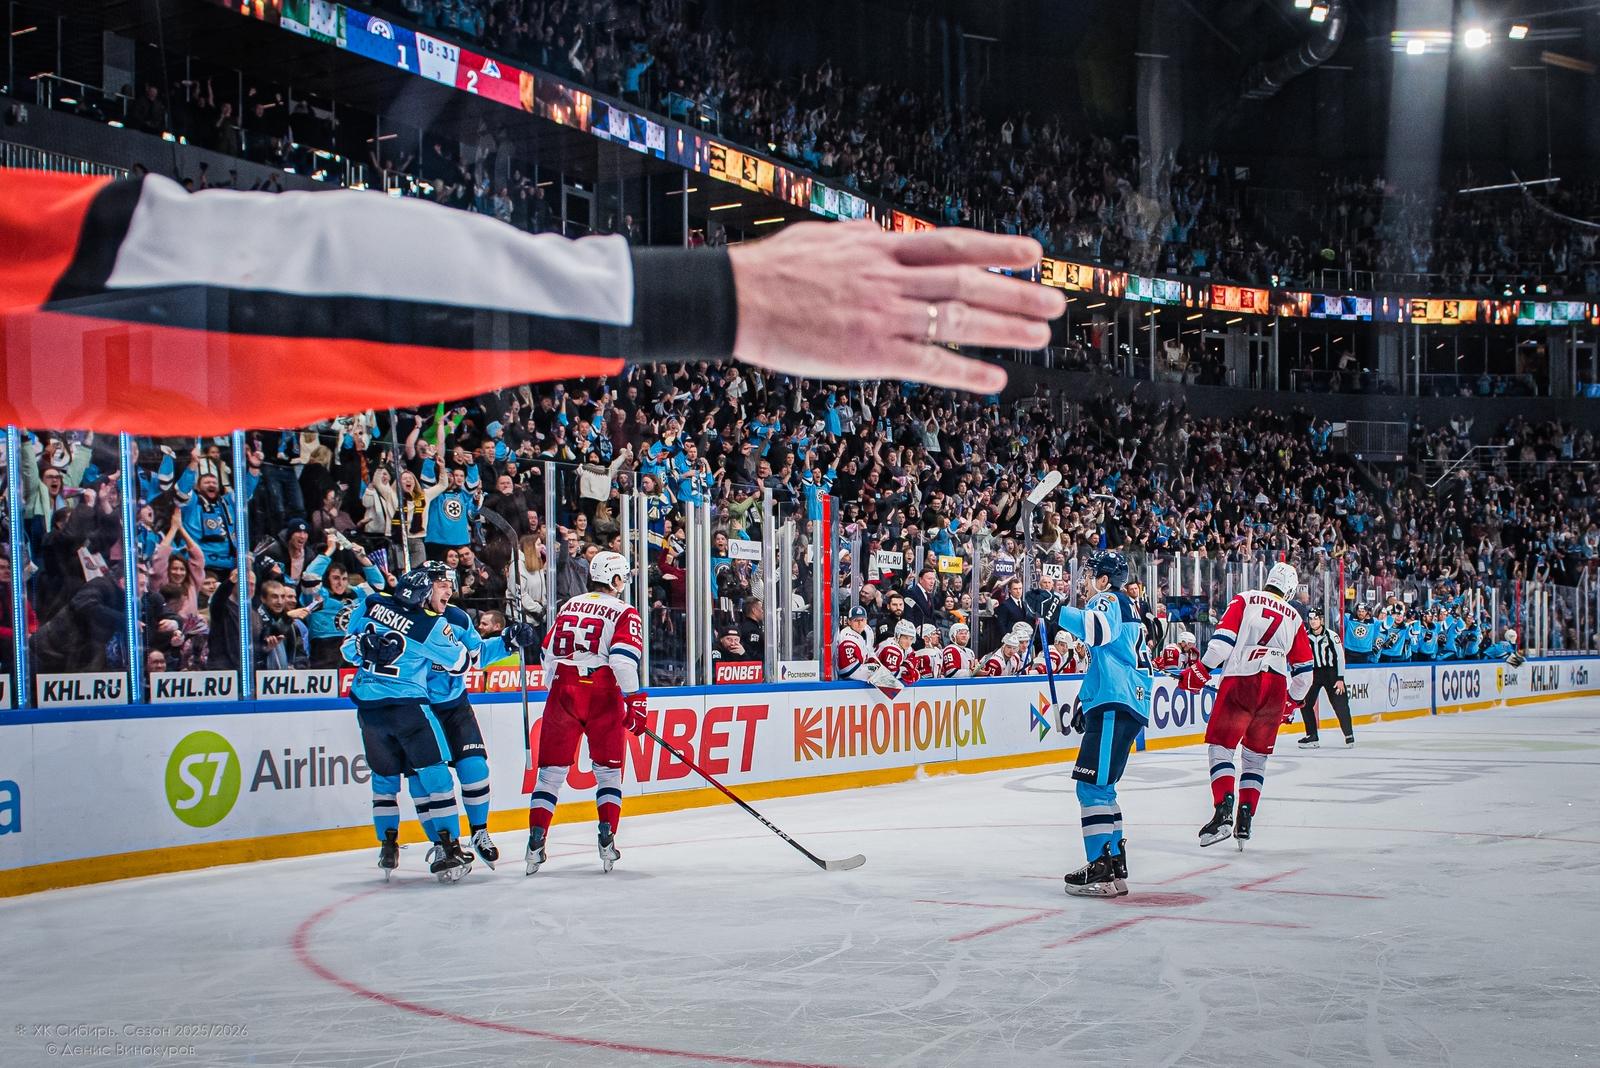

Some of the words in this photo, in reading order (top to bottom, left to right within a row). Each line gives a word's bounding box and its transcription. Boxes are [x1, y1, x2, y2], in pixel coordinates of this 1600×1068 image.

[397, 44, 409, 70] 1
[419, 38, 456, 62] 06:31
[466, 70, 478, 94] 2
[878, 553, 902, 565] KHL.RU
[402, 588, 412, 599] 22
[369, 603, 414, 635] PRISKIE
[561, 602, 622, 622] ASKOVSKY
[1249, 595, 1297, 621] KIRYANOV
[553, 614, 604, 656] 63
[1257, 607, 1284, 646] 7
[262, 675, 333, 695] KHL.RU
[717, 665, 762, 682] FONBET
[1442, 669, 1481, 702] согаз
[1504, 673, 1518, 687] БАНК
[1530, 664, 1560, 692] KHL.RU
[43, 679, 122, 702] KHL.RU
[156, 676, 232, 698] KHL.RU
[1153, 686, 1218, 730] сога
[794, 698, 987, 762] КИНОПОИСК
[176, 751, 229, 810] S7
[249, 746, 371, 793] Airline
